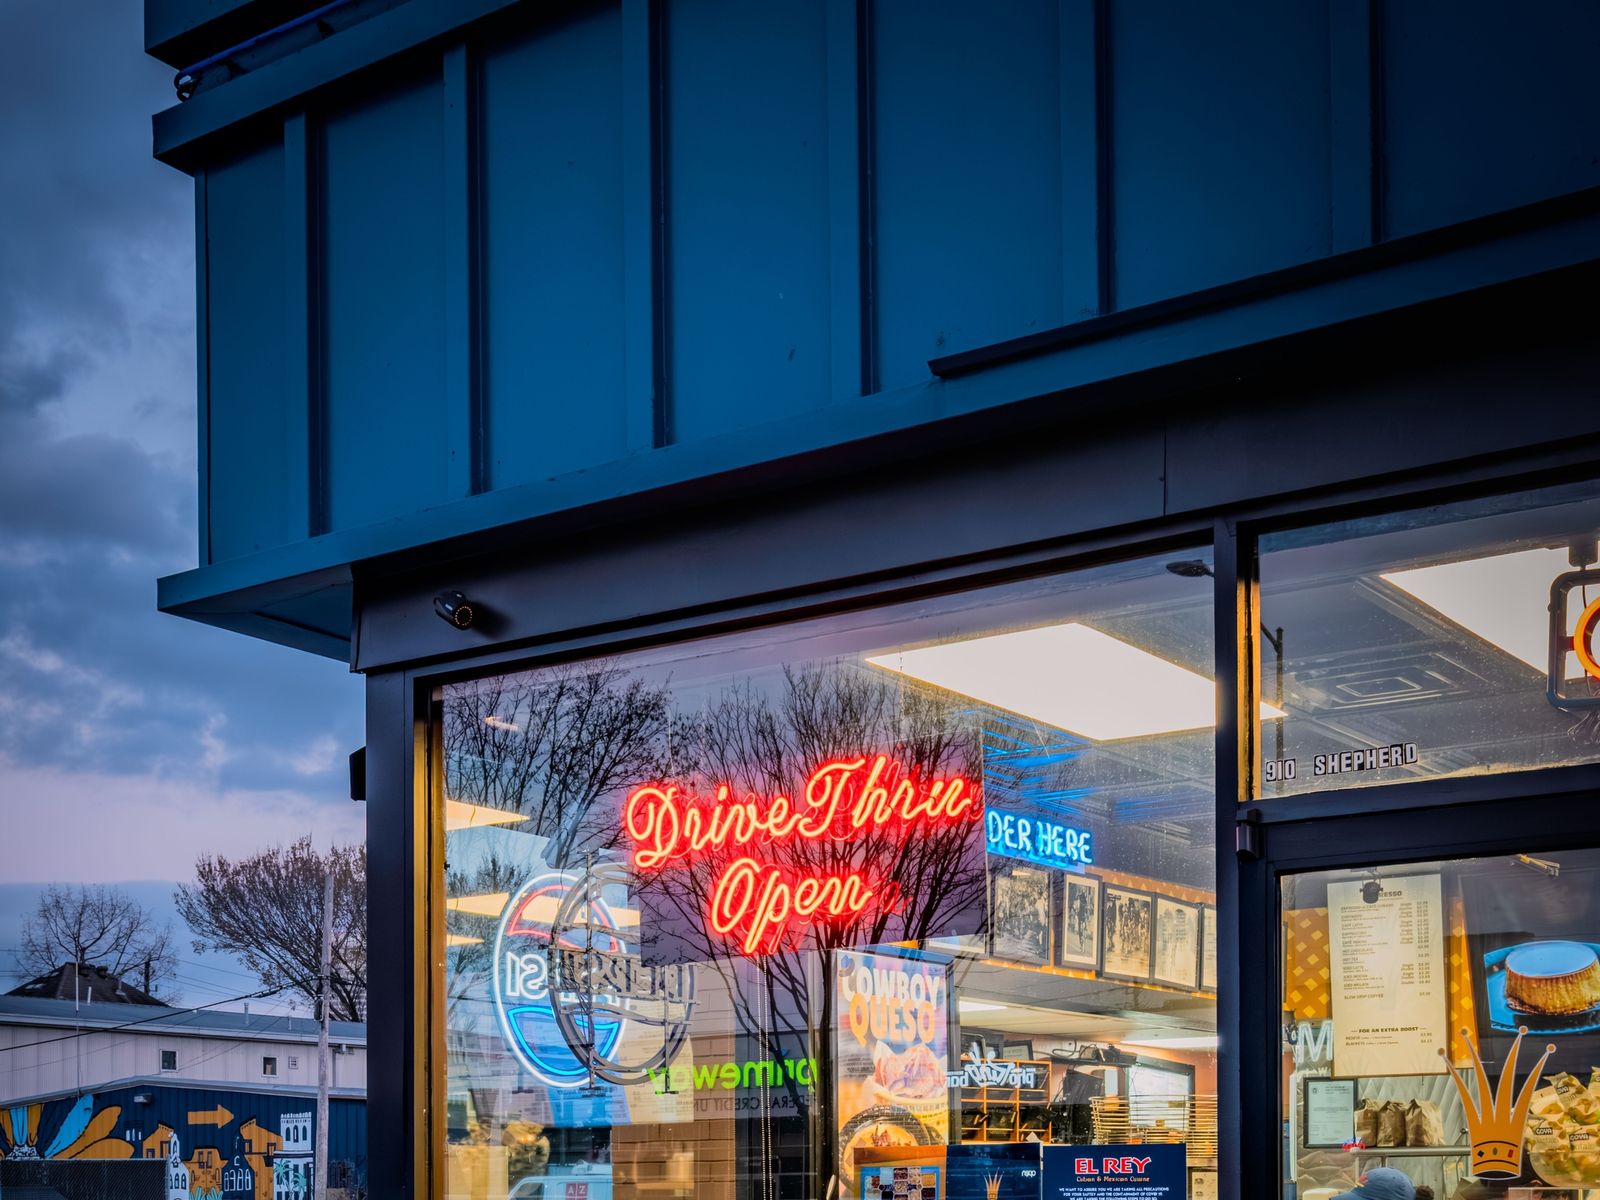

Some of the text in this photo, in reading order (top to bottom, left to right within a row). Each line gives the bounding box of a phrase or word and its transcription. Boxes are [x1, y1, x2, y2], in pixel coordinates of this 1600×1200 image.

[1266, 743, 1417, 782] 910 SHEPHERD
[626, 756, 972, 868] Drive Thru
[988, 810, 1093, 863] DER HERE
[712, 857, 872, 953] Open
[1378, 890, 1402, 898] RESSO
[842, 966, 941, 1010] COWBOY
[849, 991, 936, 1048] QUESO
[1075, 1157, 1152, 1174] EL REY
